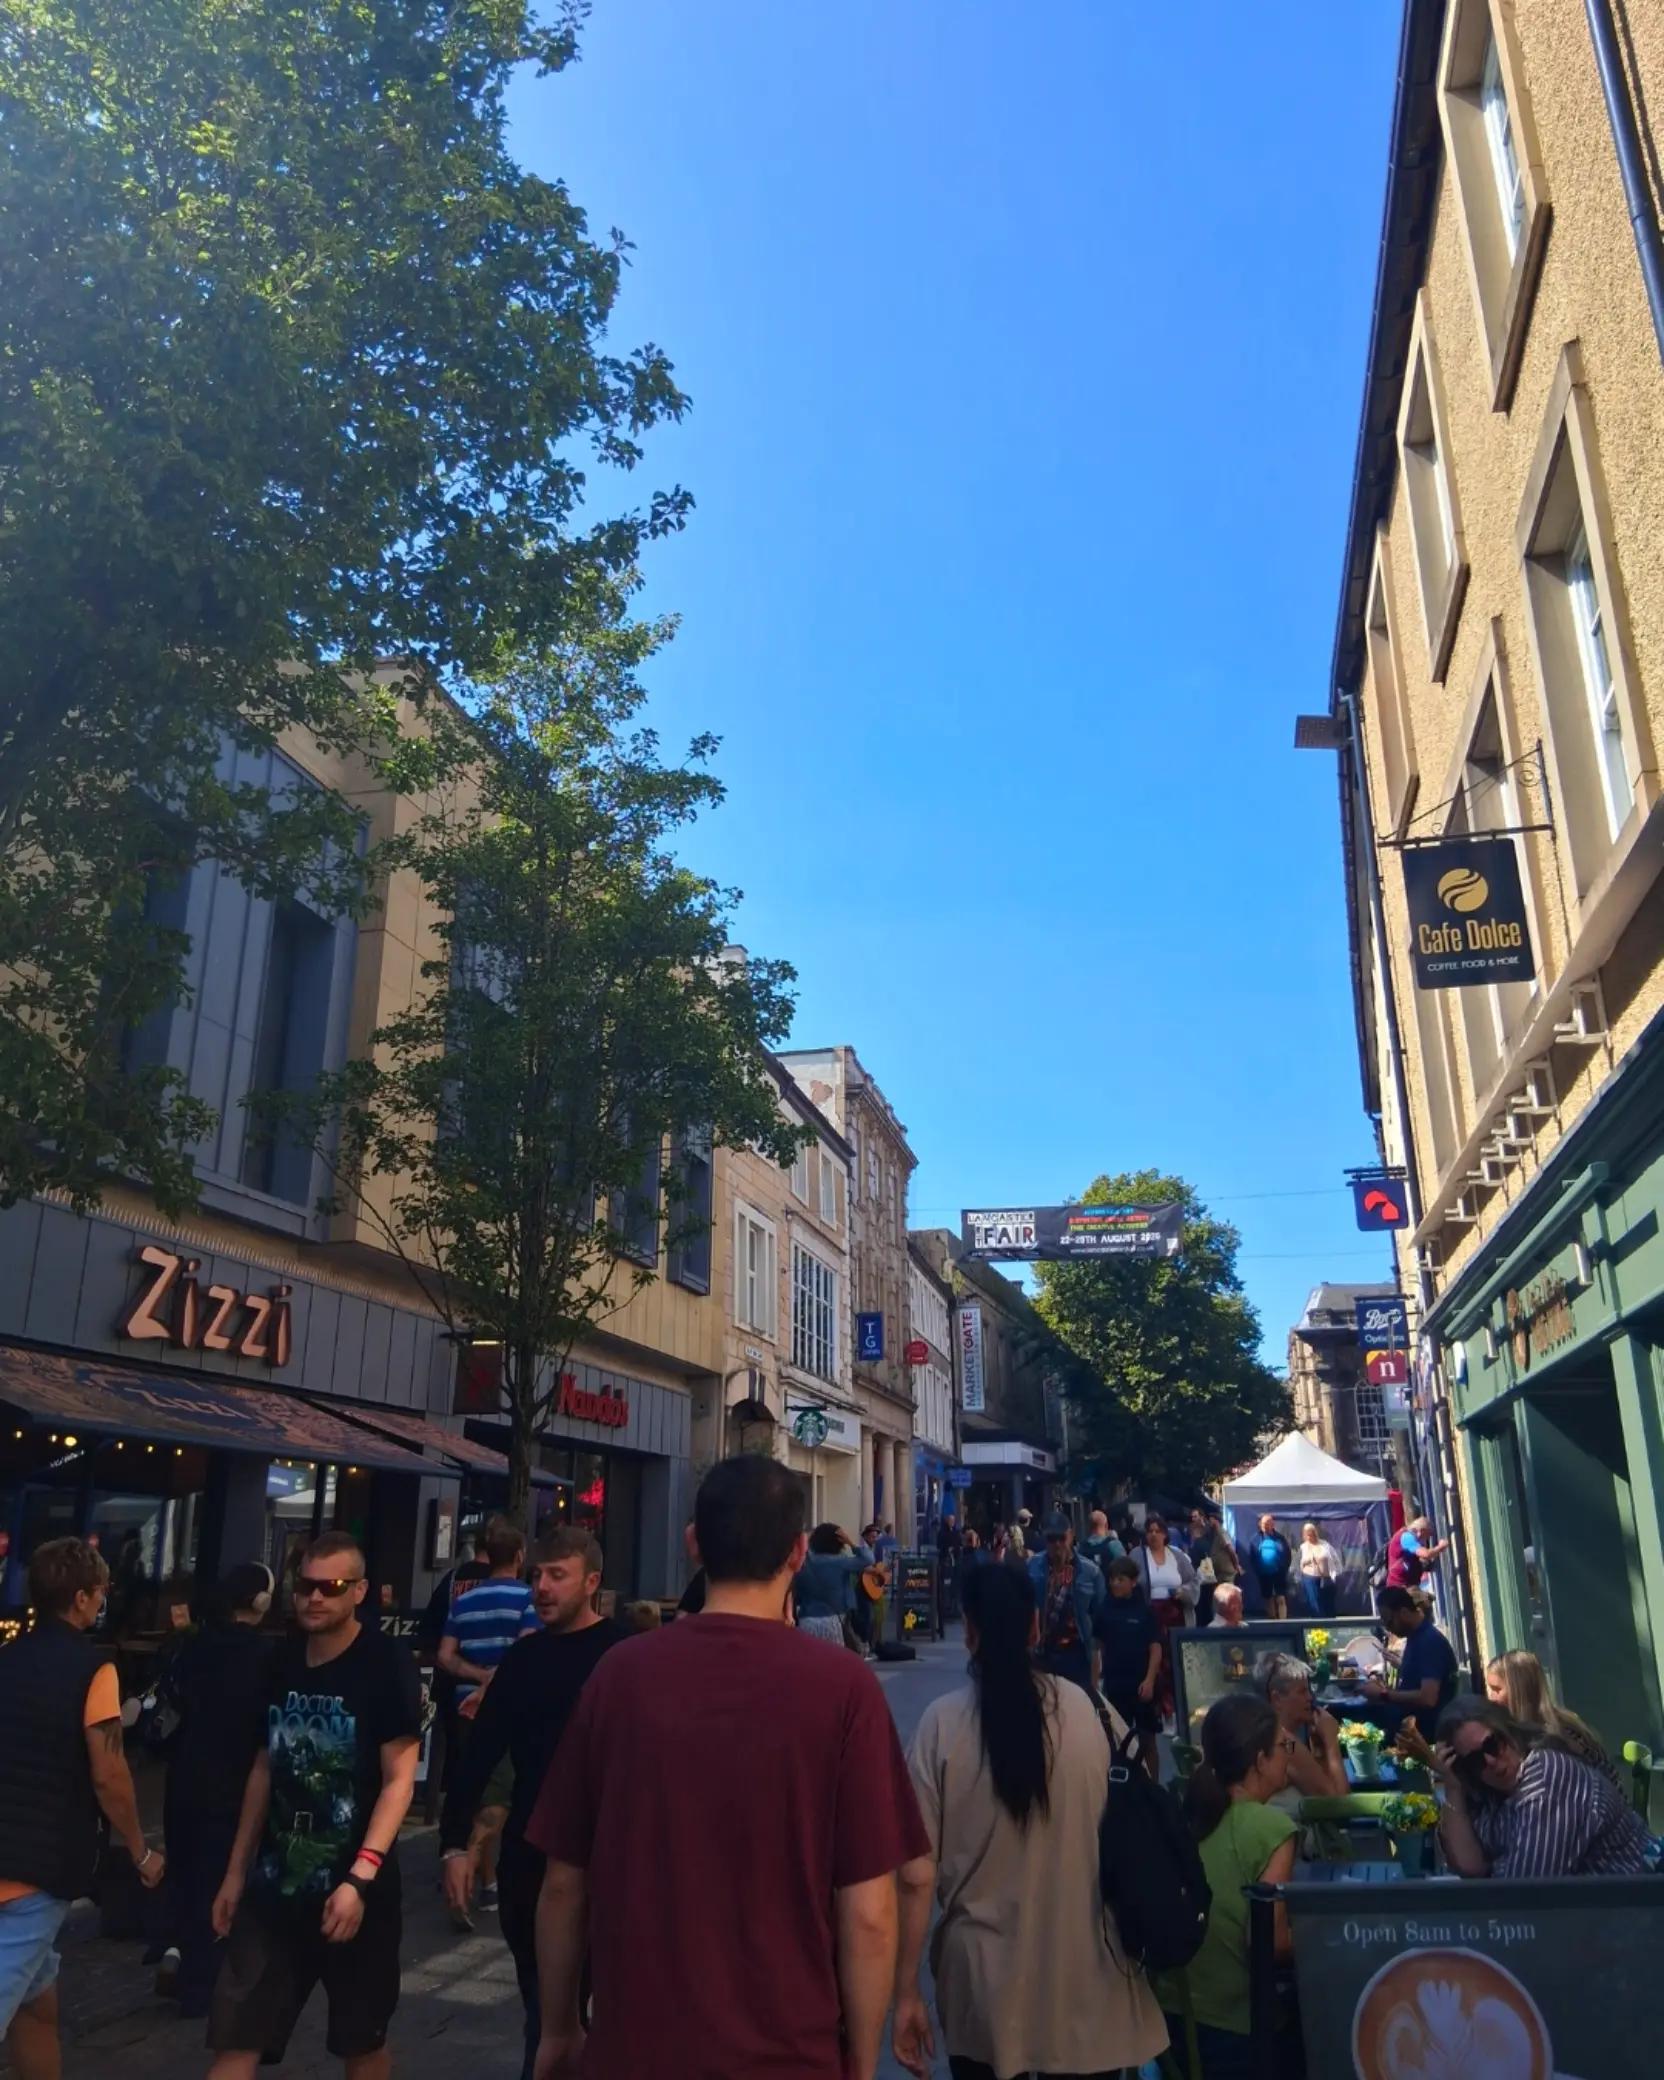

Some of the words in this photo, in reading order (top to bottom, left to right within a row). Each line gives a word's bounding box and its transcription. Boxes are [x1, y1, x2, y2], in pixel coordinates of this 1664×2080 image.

[1418, 921, 1463, 955] Cafe
[1466, 917, 1523, 951] Dolce
[1461, 959, 1486, 968] FOOD
[1488, 958, 1495, 967] &
[984, 1226, 1035, 1246] FAIR
[1100, 1233, 1136, 1244] AUGUST
[126, 1245, 293, 1368] Zizzi
[962, 1310, 979, 1407] MARKETGATE
[1379, 1360, 1396, 1378] n
[1343, 1921, 1398, 1948] Open
[1404, 1920, 1450, 1942] 8am
[1459, 1922, 1480, 1940] to
[1488, 1919, 1535, 1946] 5pm
